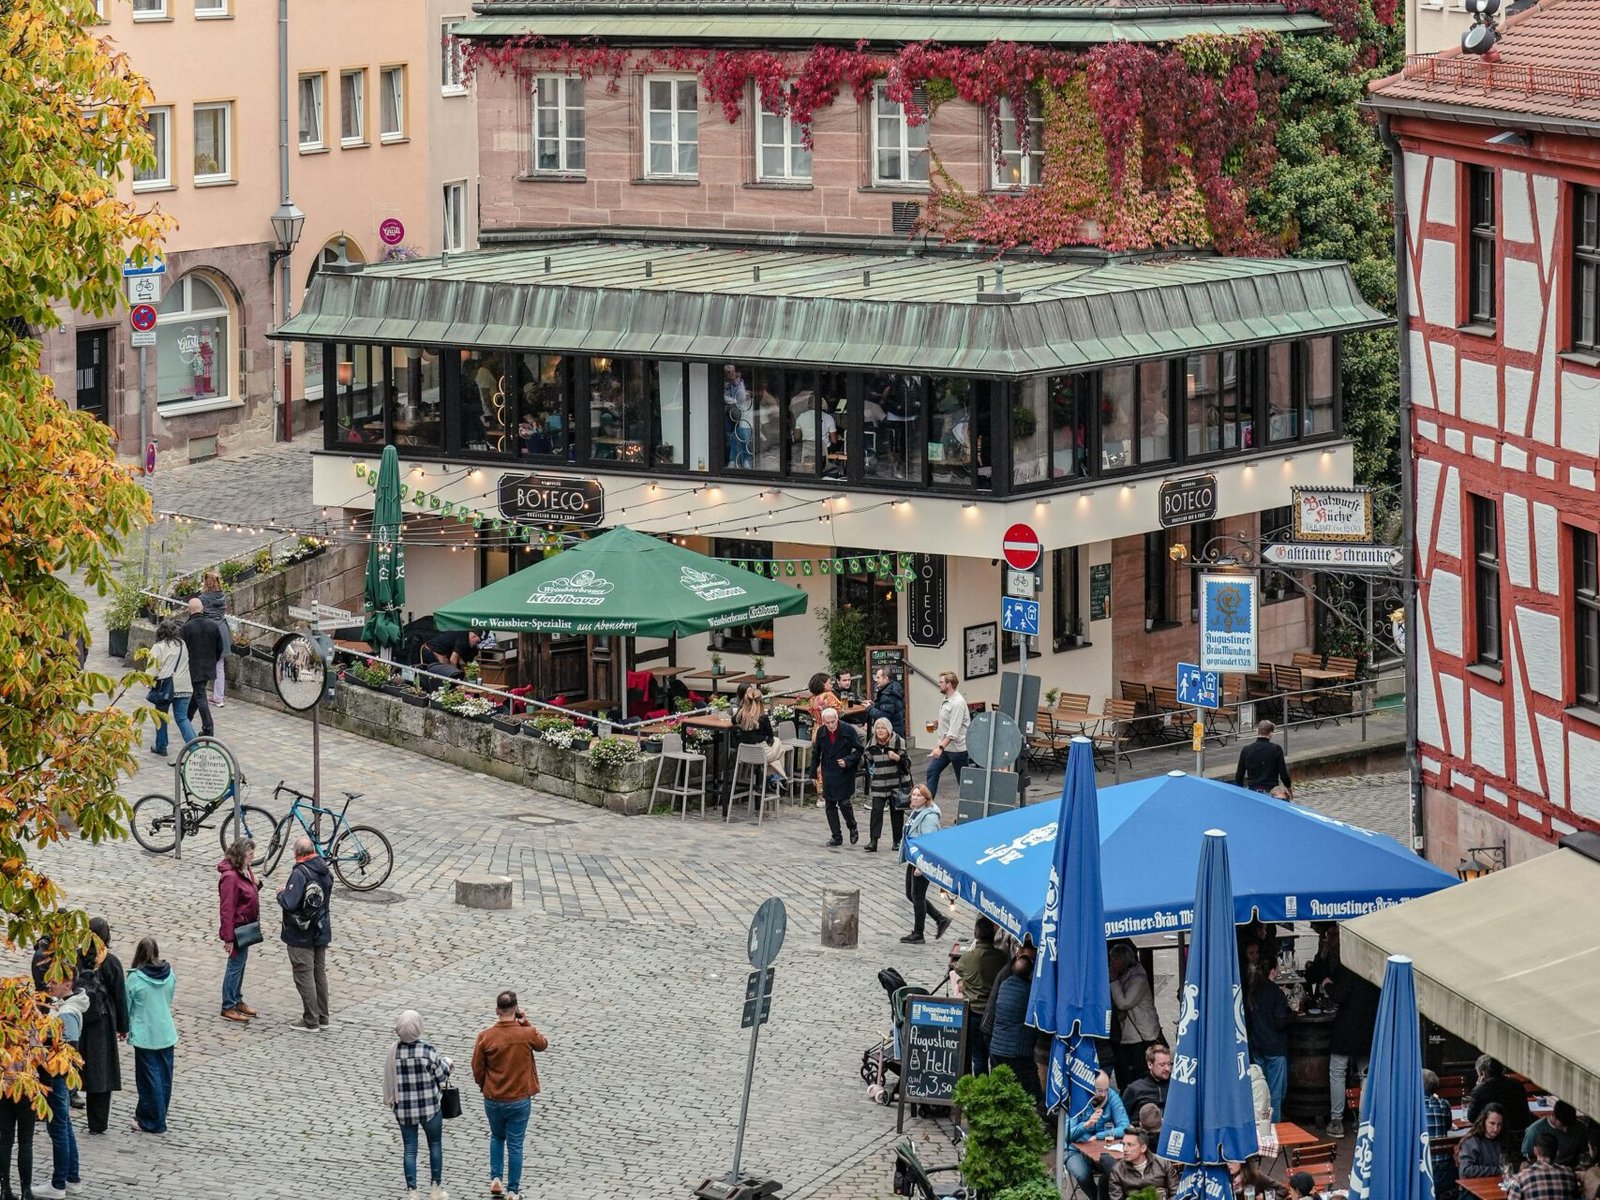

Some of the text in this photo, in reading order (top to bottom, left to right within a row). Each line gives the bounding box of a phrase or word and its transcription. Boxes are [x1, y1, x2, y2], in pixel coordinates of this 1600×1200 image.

[517, 488, 584, 511] BOTECO
[1165, 488, 1212, 514] BOTECO
[1315, 507, 1353, 523] Küche
[528, 593, 604, 605] Kuchlbauer
[471, 617, 638, 633] Der Weissbier-Spezialist aus Abensberg
[910, 1025, 959, 1052] Augustiner
[925, 1050, 952, 1074] Hell
